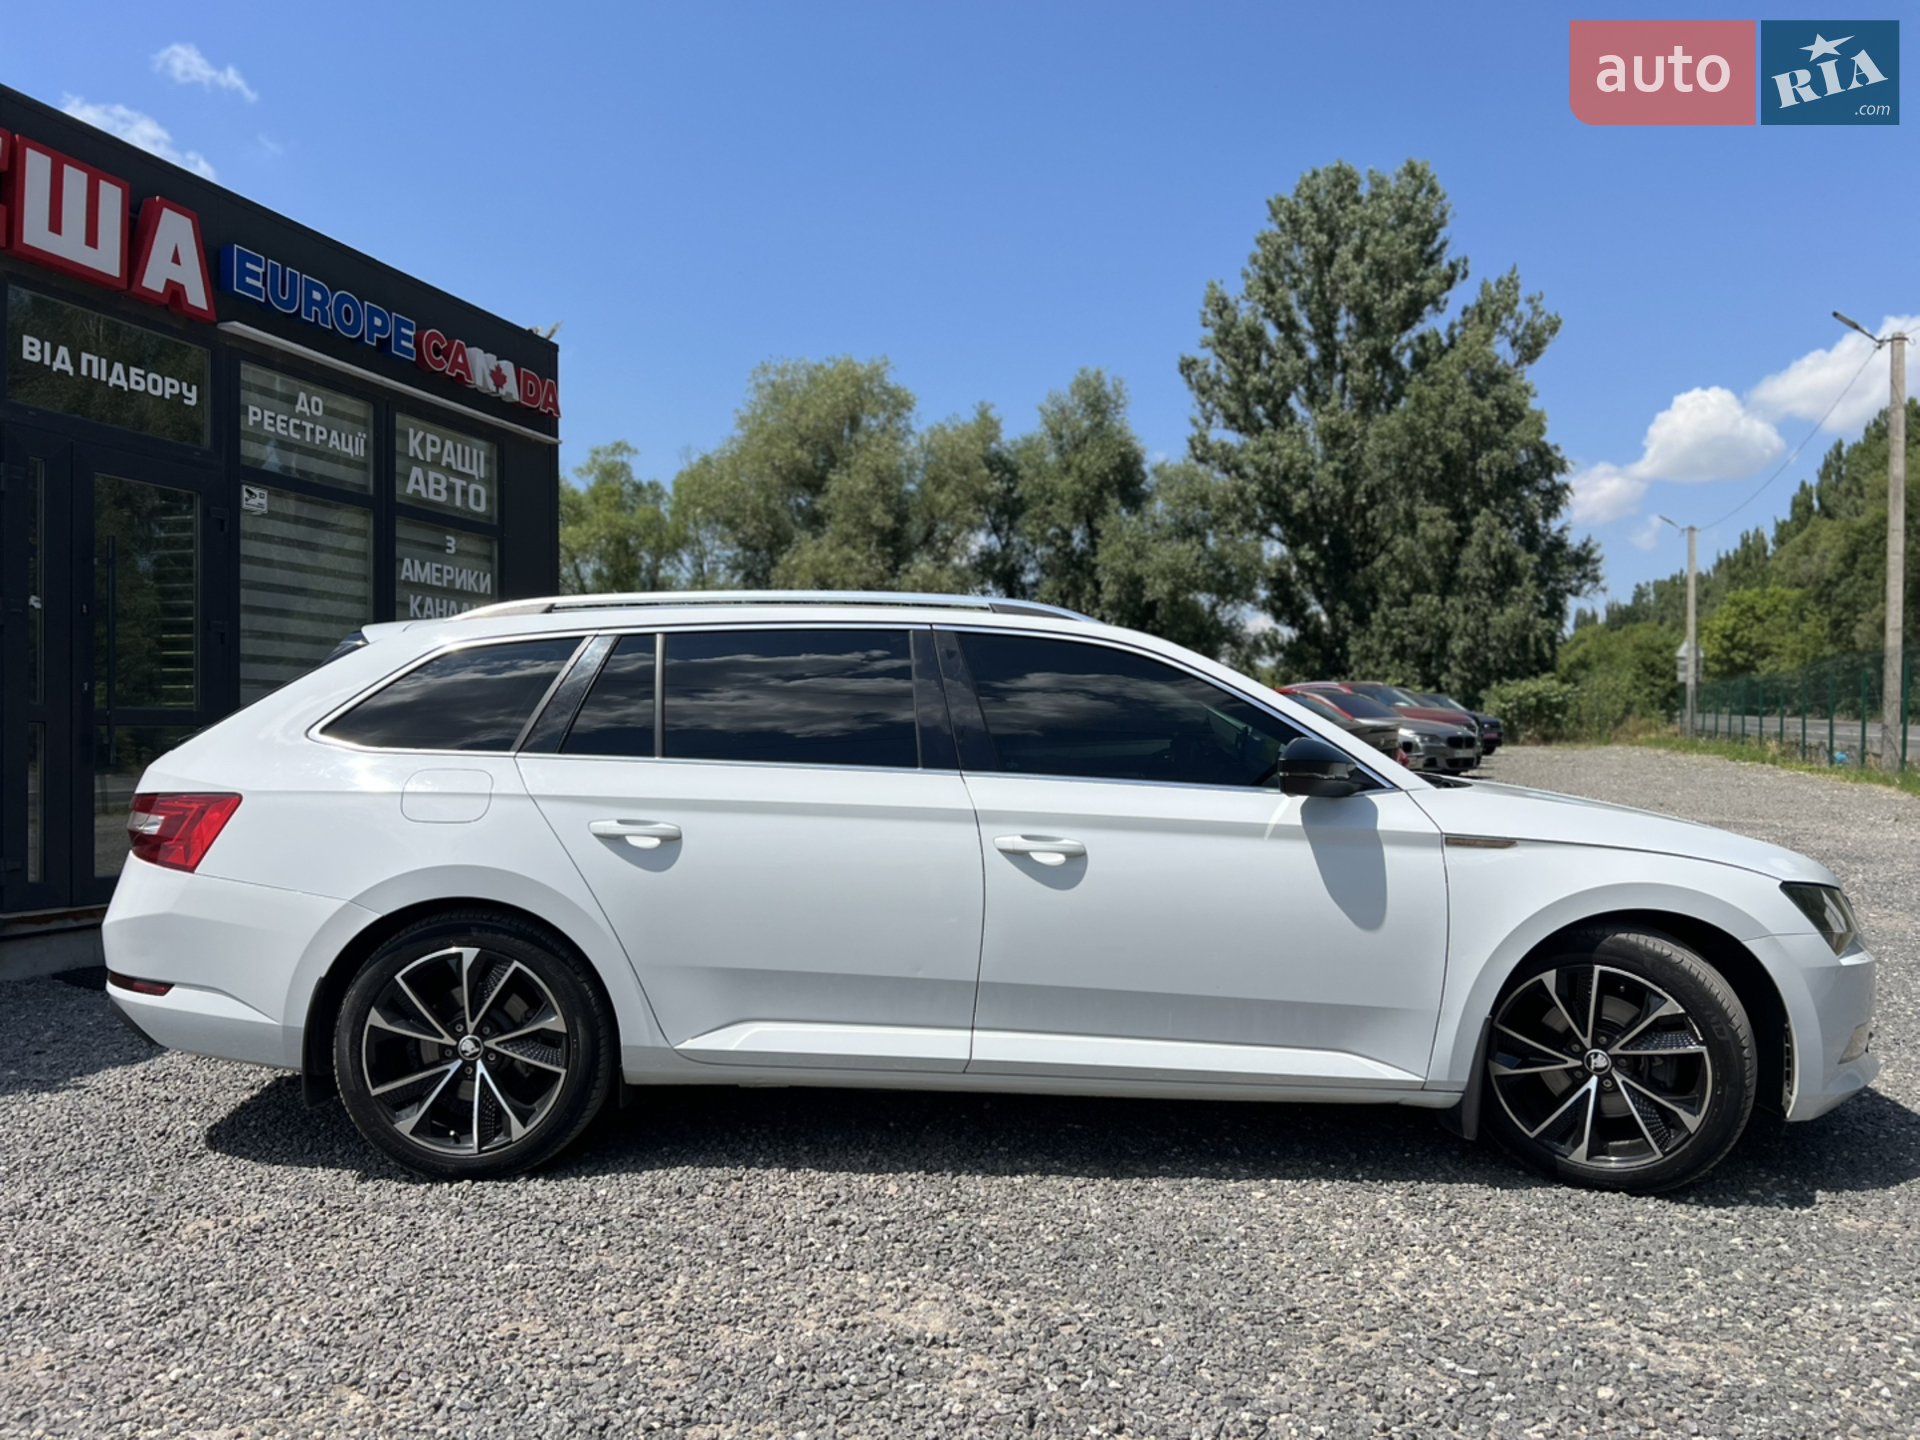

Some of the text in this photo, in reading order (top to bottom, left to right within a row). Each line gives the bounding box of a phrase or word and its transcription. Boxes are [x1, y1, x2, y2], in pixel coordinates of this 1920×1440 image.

[0, 132, 214, 320] ША
[231, 244, 562, 418] EUROPE CANADA
[22, 334, 197, 406] ВІД ПІДБОРУ
[248, 404, 367, 457] РЕЄСТРАЦІЇ
[295, 391, 324, 417] ДО
[408, 427, 485, 480] КРАЩІ
[406, 466, 487, 513] АВТО
[400, 558, 492, 595] АМЕРИКИ
